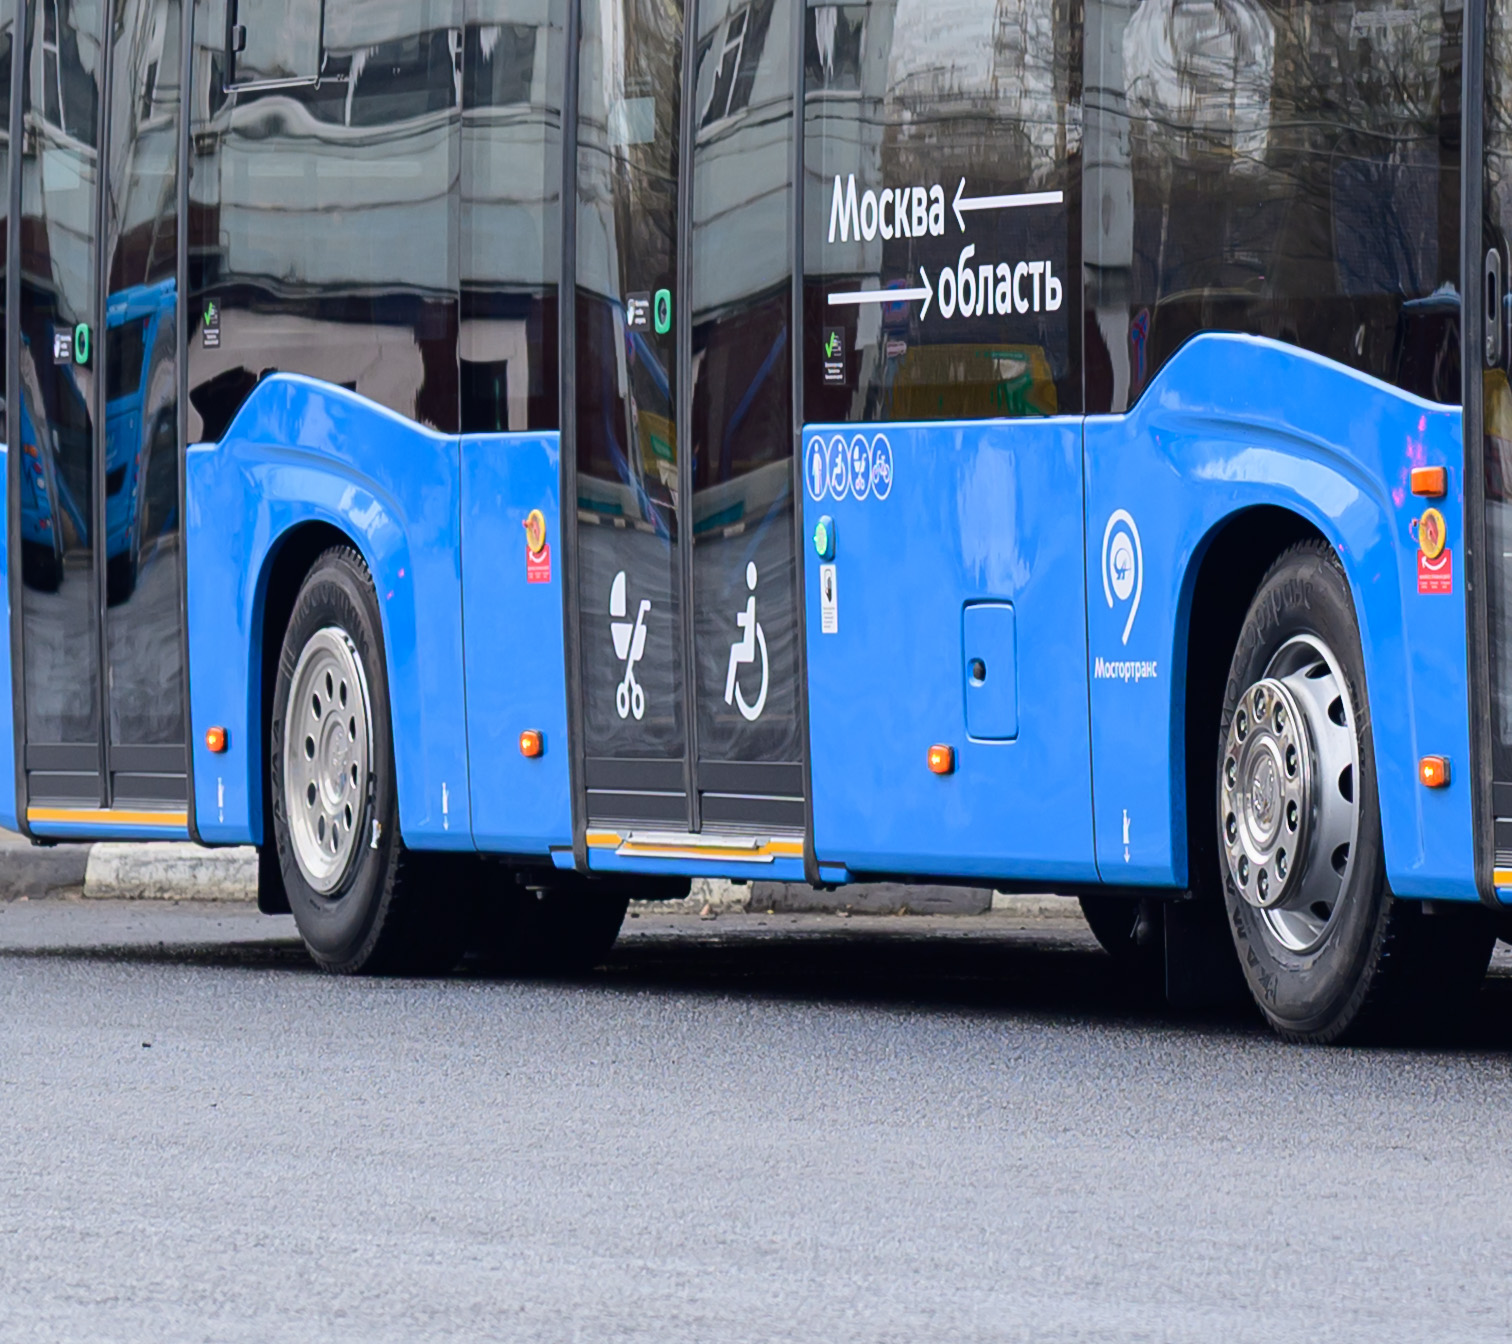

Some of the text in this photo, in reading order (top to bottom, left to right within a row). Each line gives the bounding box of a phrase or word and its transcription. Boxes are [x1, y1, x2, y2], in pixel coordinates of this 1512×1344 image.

[828, 173, 945, 243] Москва
[938, 244, 1062, 319] область
[1094, 657, 1157, 683] Мосгортранс
